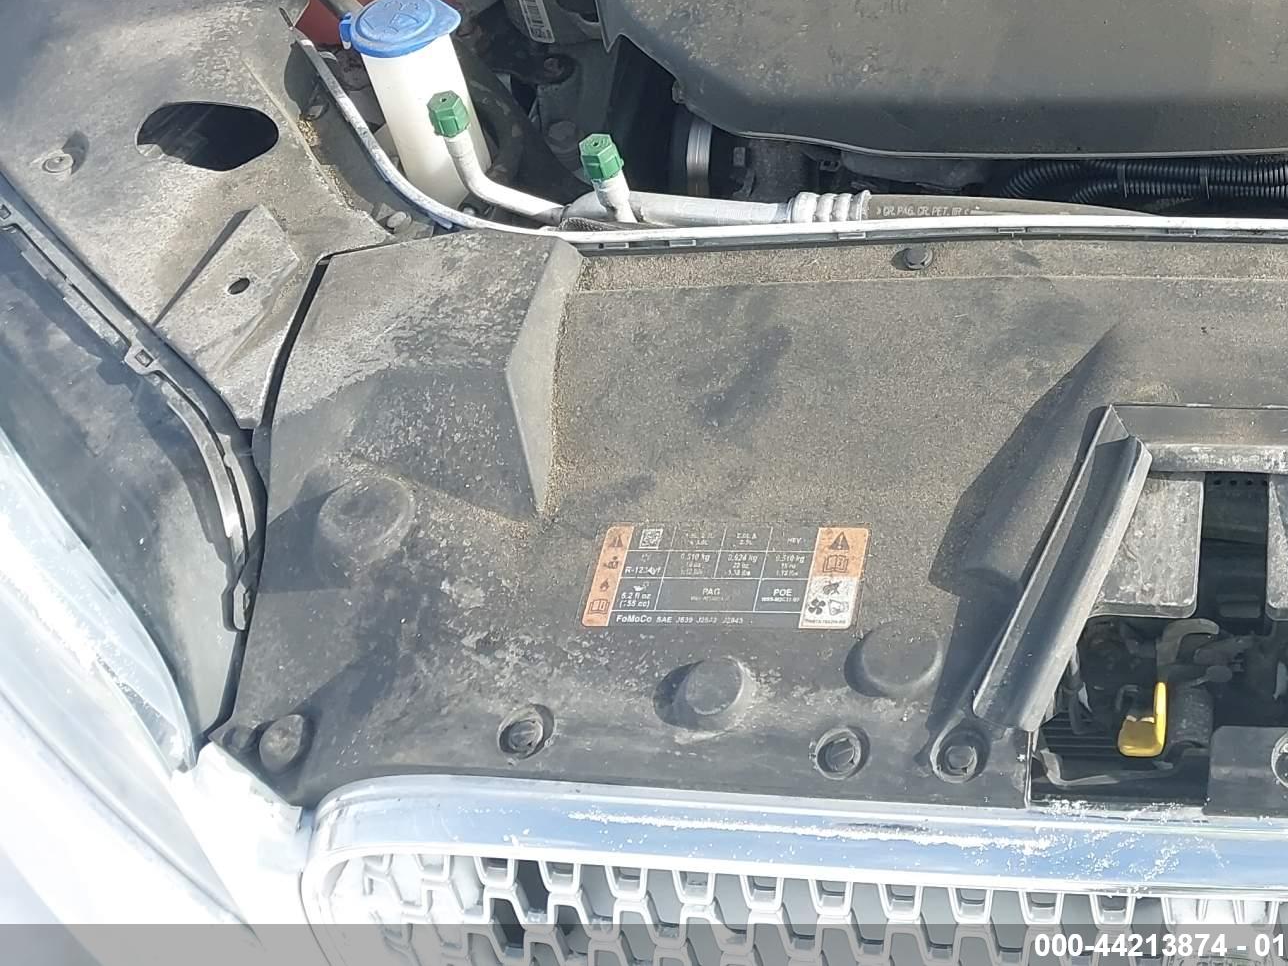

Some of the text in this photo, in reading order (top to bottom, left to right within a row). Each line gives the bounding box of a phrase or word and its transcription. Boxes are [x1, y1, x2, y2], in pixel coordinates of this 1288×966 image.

[772, 588, 793, 597] POE
[616, 614, 653, 623] FoMoCo
[656, 615, 673, 624] SAE
